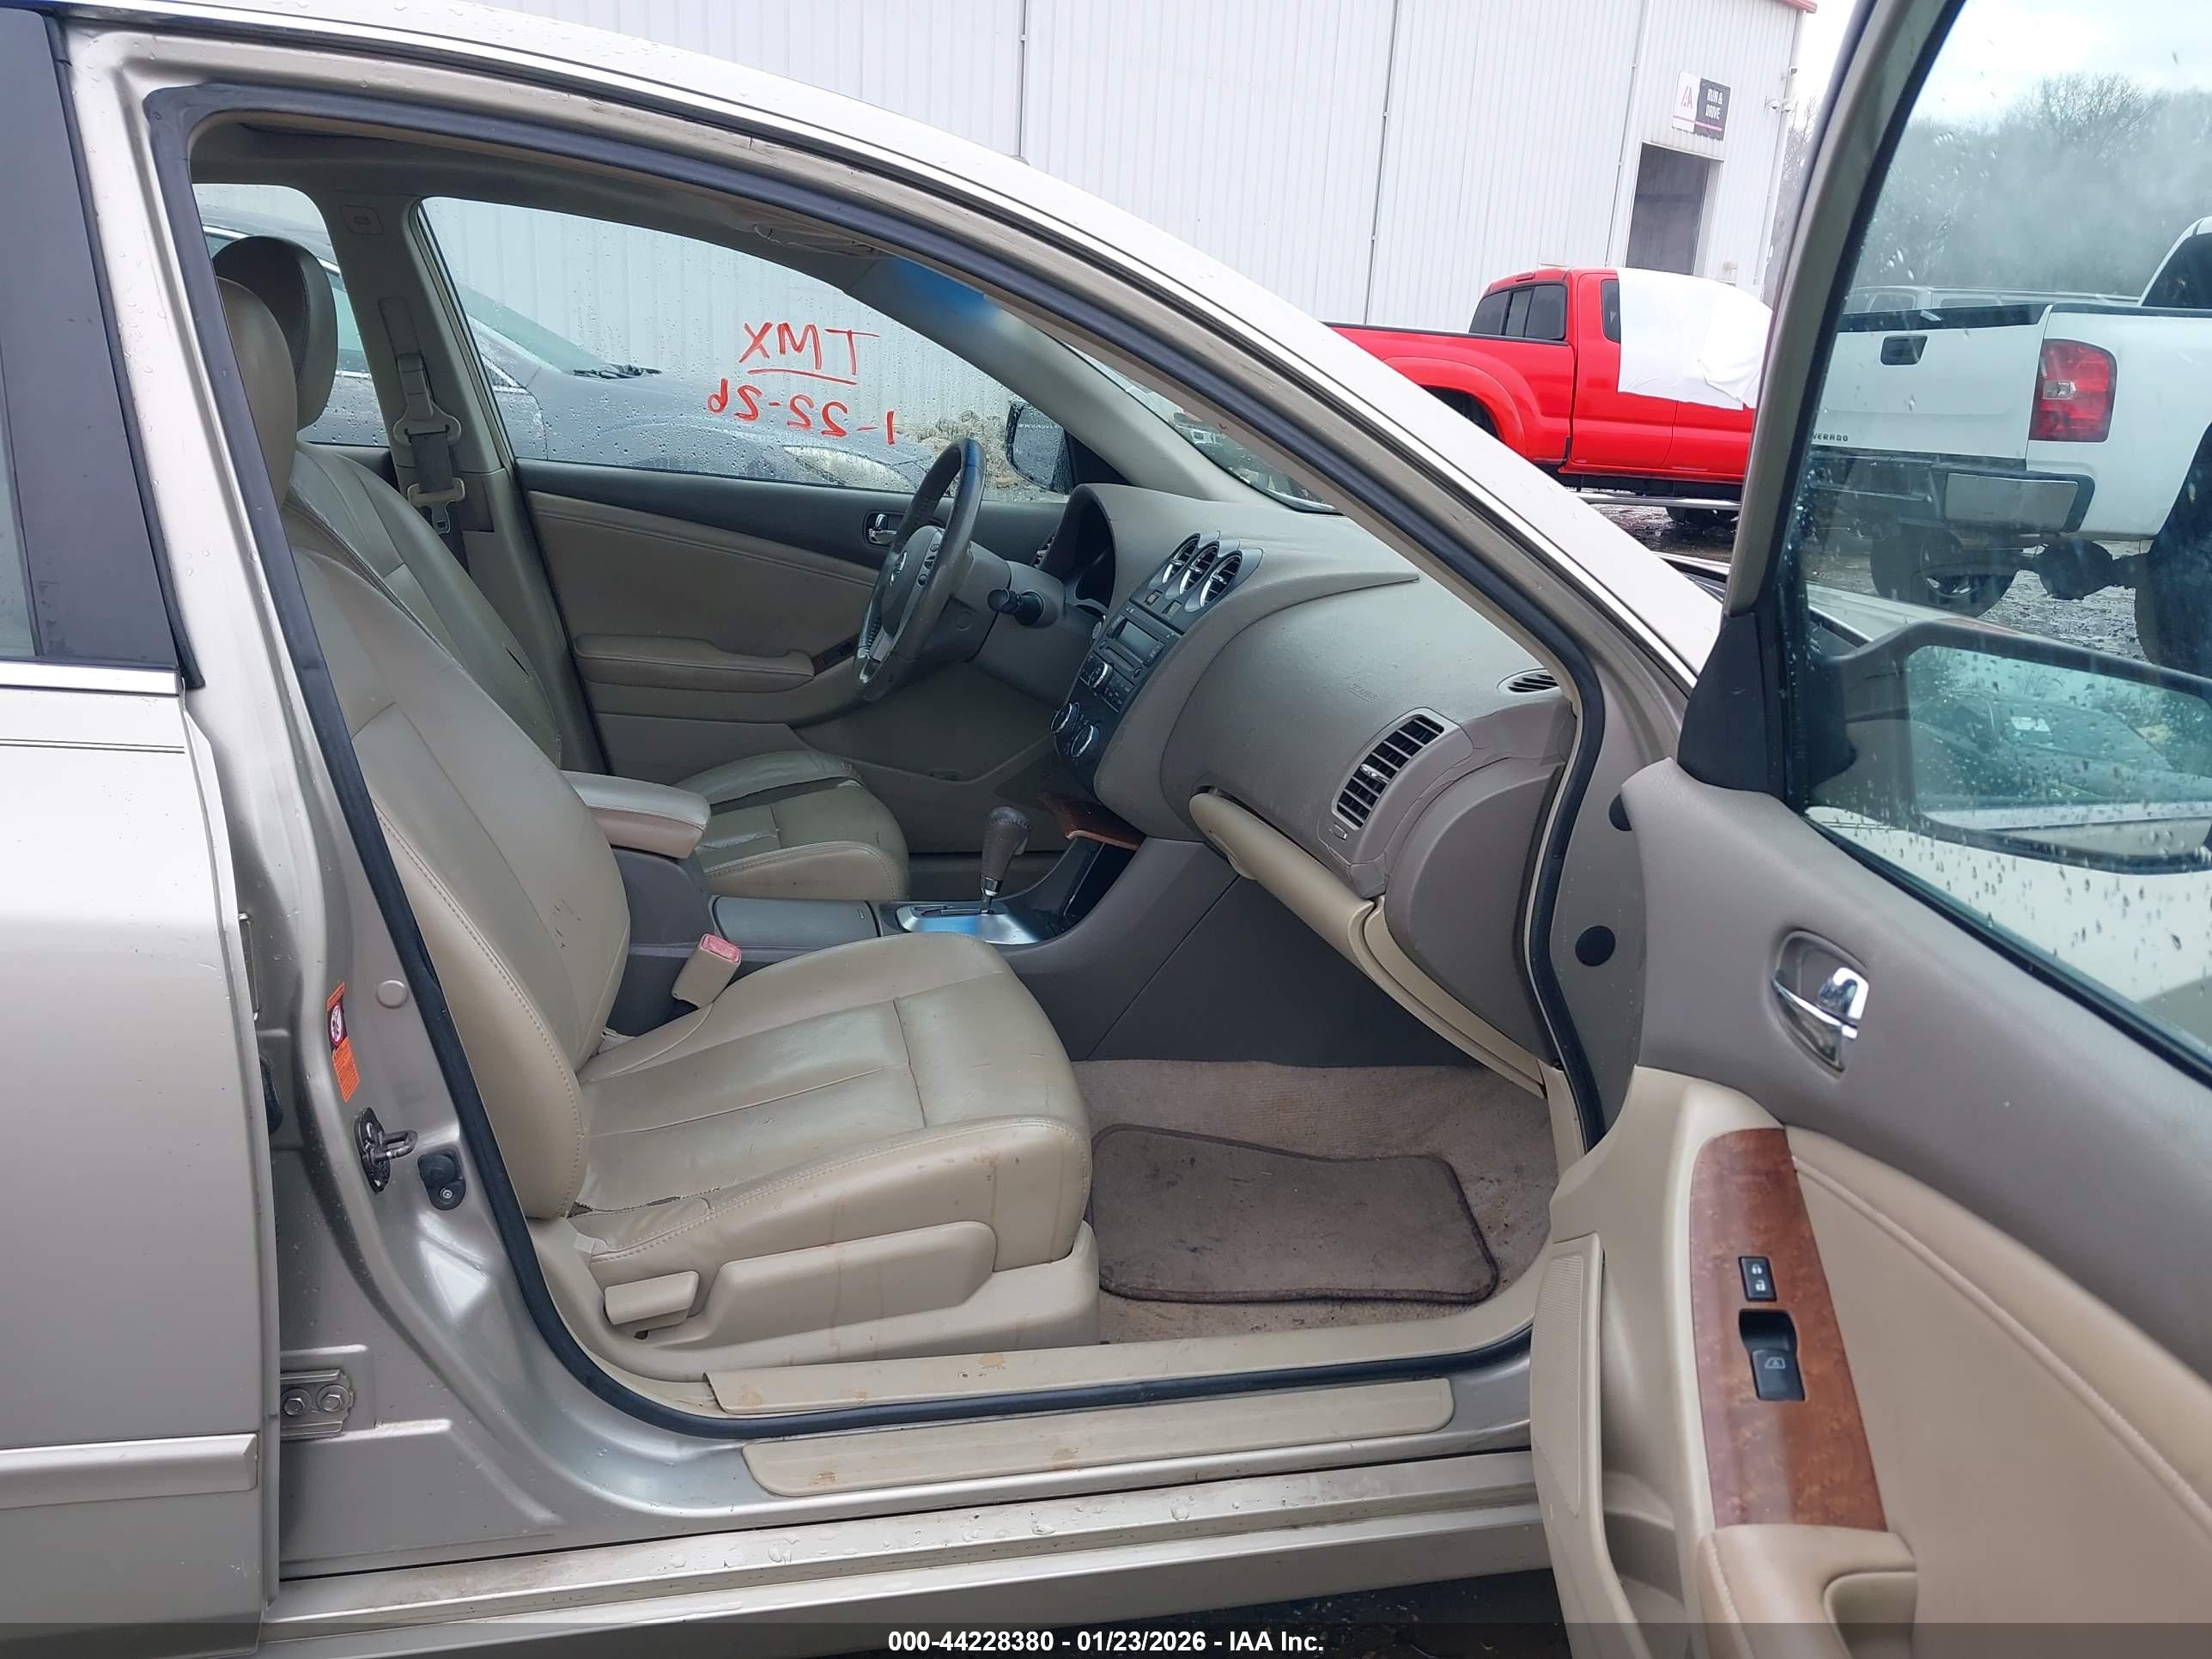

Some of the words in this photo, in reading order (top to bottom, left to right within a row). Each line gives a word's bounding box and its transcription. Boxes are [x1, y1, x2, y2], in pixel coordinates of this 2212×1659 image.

[1706, 88, 1718, 104] RUN
[1718, 92, 1723, 105] &
[1705, 104, 1721, 119] DRIVE
